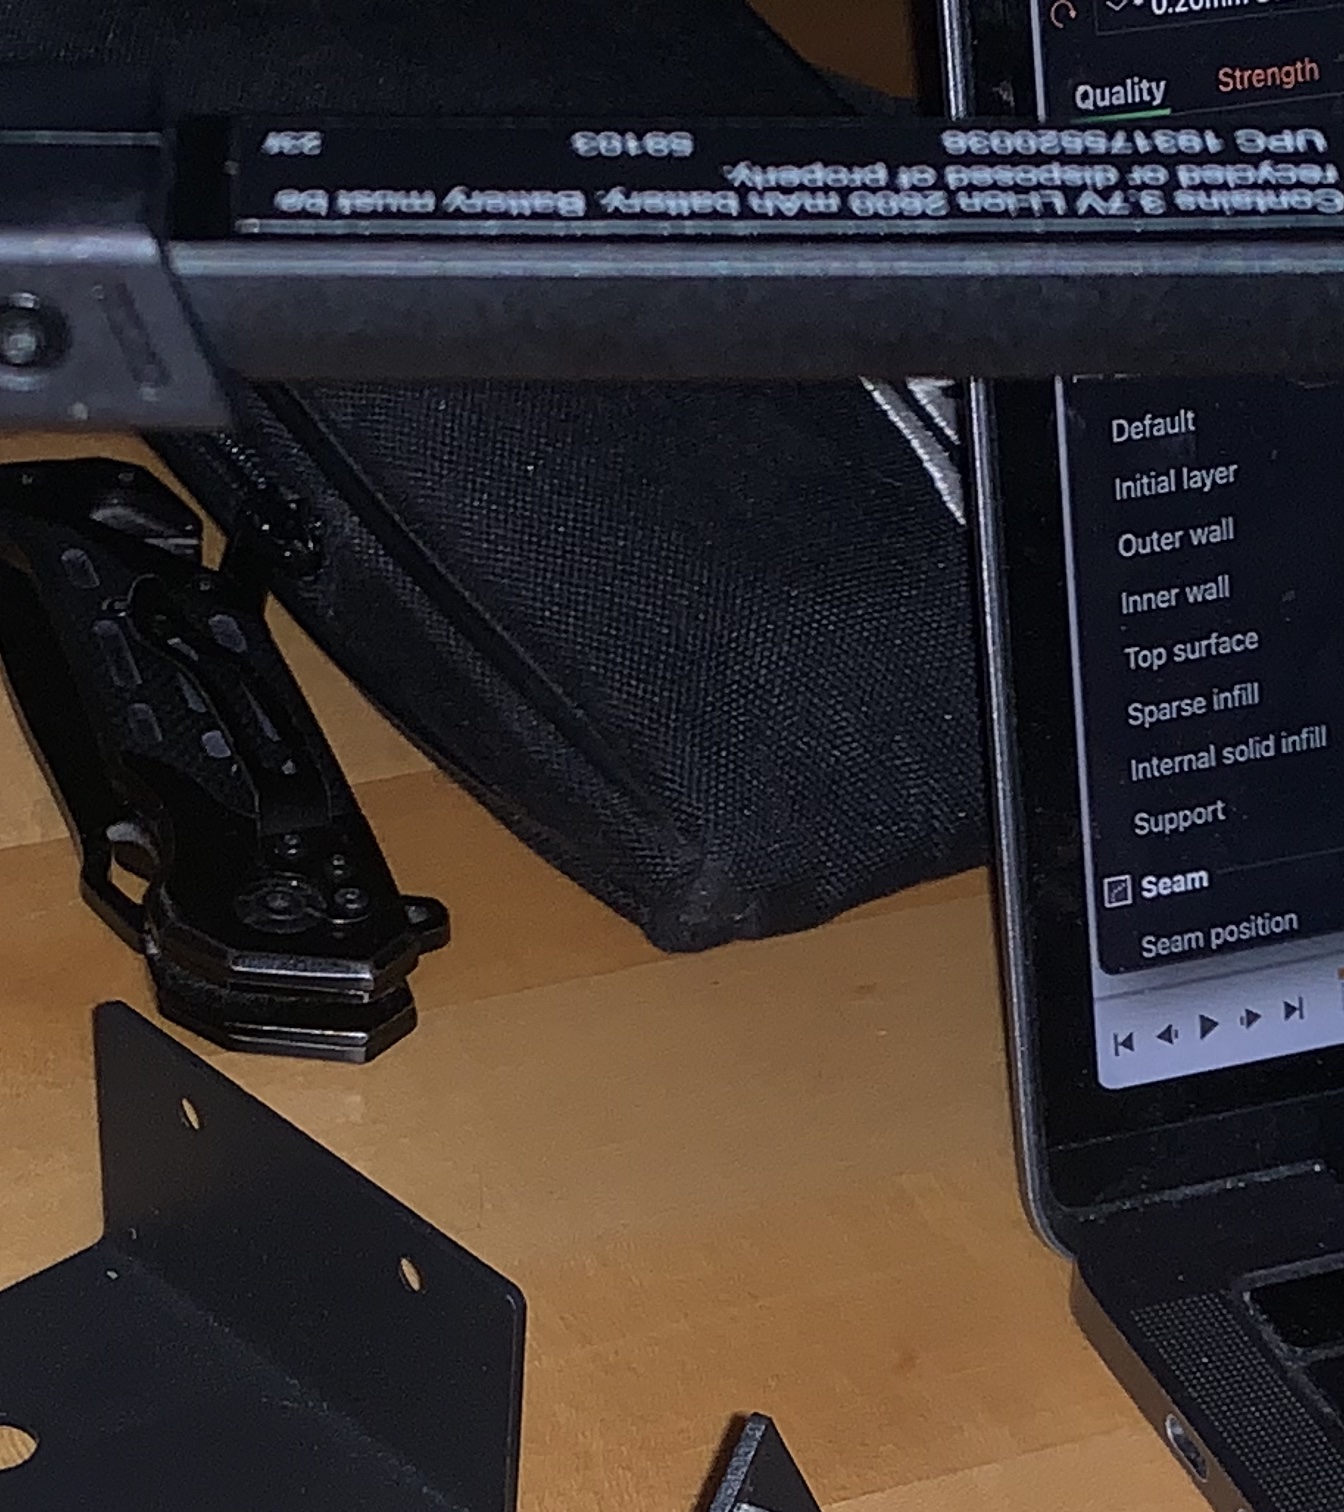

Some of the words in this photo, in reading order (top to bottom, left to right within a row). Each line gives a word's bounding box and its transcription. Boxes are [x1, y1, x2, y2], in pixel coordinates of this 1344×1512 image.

[1075, 76, 1167, 110] Quality
[1218, 57, 1321, 94] Strength
[1234, 129, 1330, 156] UPC
[944, 161, 1121, 191] disposed
[1127, 163, 1170, 188] or
[273, 188, 329, 218] be
[335, 188, 437, 217] must
[443, 185, 587, 218] Battery
[1111, 409, 1196, 444] Default
[1114, 468, 1177, 501] Initial
[1181, 461, 1239, 495] layer
[1118, 525, 1183, 558] Outer
[1188, 517, 1235, 548] wall
[1121, 583, 1179, 615] Inner
[1184, 574, 1231, 606] wall
[1125, 641, 1167, 671] Top
[1173, 628, 1260, 665] surface
[1126, 691, 1208, 730] Sparse
[1212, 682, 1260, 713] infill
[1130, 742, 1217, 783] Internal
[1222, 734, 1276, 766] solid
[1281, 725, 1328, 755] infill
[1134, 800, 1227, 837] Support
[1140, 868, 1209, 900] Seam
[1141, 928, 1206, 960] Seam
[1210, 909, 1299, 952] position
